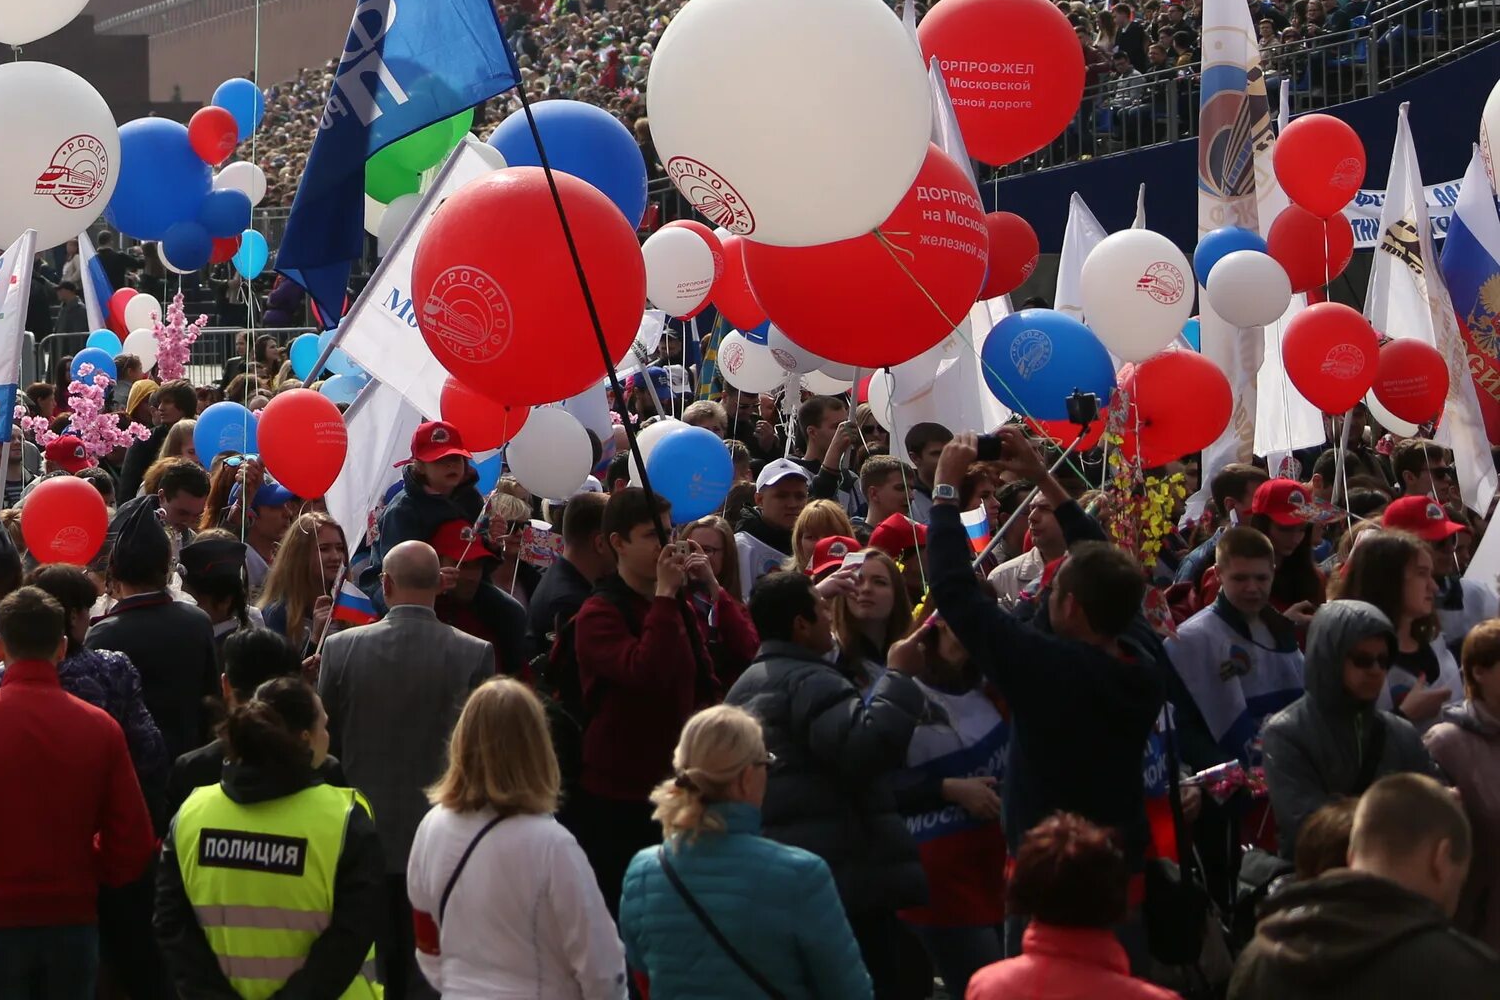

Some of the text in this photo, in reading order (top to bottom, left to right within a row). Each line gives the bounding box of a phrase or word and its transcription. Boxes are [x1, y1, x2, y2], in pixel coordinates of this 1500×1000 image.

[939, 59, 1034, 76] ОРПРОФЖЕЛ
[949, 77, 1031, 92] Московской
[950, 97, 1033, 111] езной дороге
[66, 137, 107, 205] РОСПРОФЖЕЛ
[922, 209, 941, 222] на
[919, 233, 977, 256] железной
[447, 270, 507, 359] РОСПРОФЖЕЛ
[205, 837, 300, 867] ПОЛИЦИЯ
